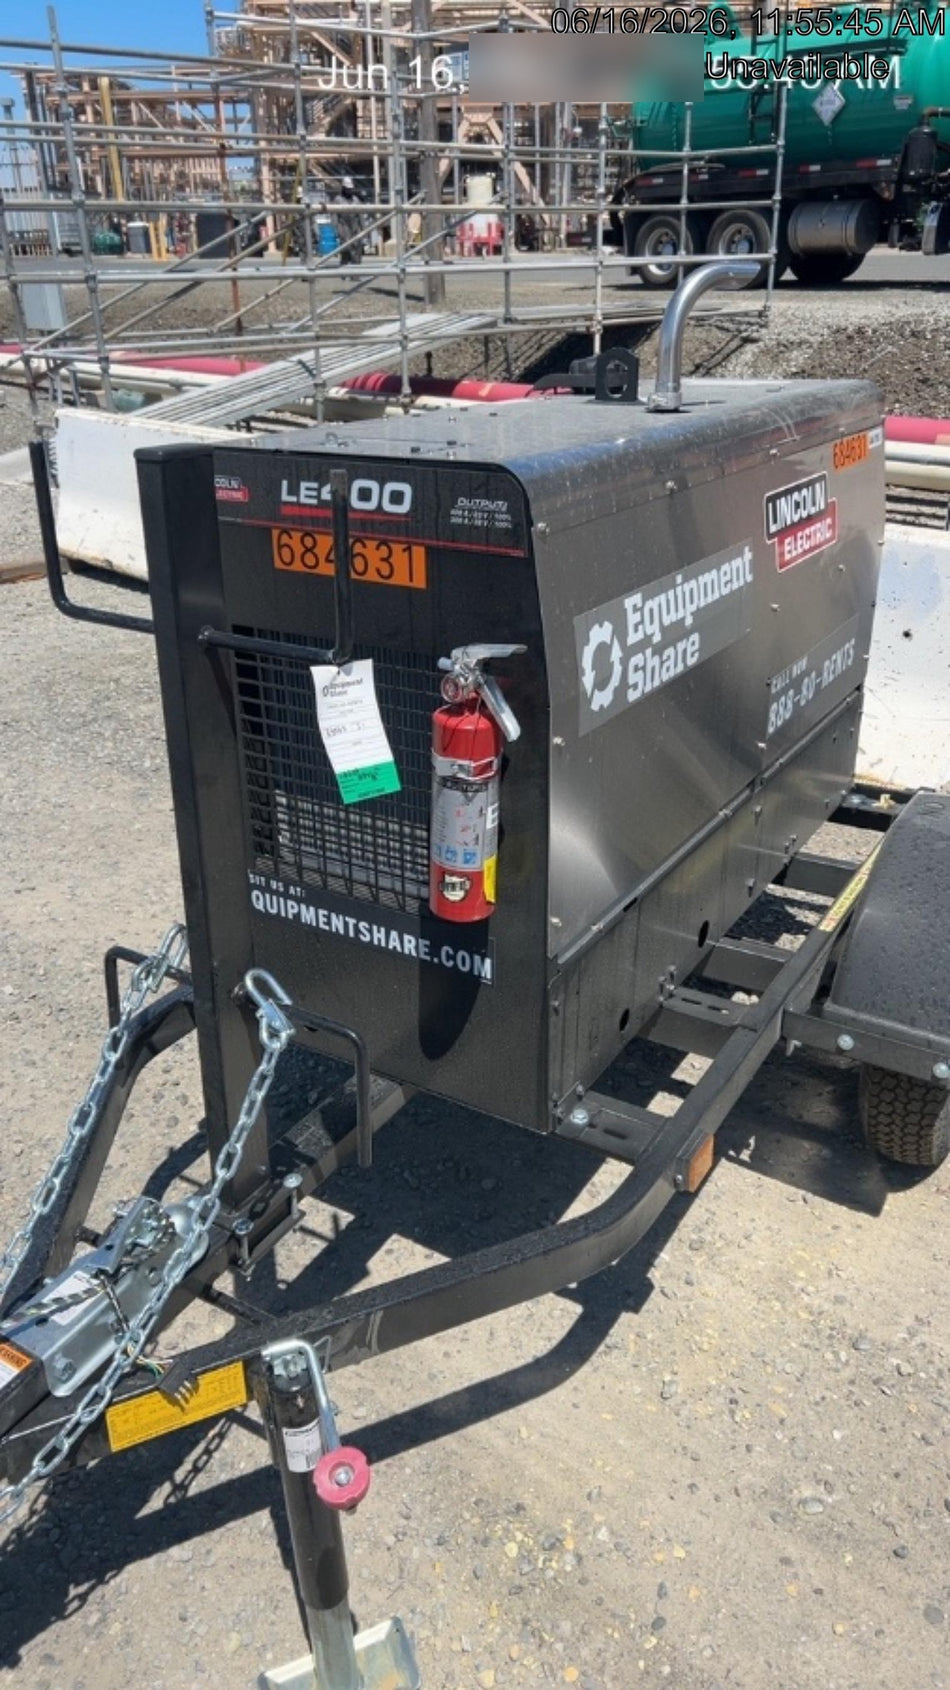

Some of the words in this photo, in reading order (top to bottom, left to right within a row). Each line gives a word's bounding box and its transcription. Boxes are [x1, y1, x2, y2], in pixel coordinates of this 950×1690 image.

[768, 480, 826, 534] LINCOLN
[784, 517, 833, 562] ELECTRIC
[624, 546, 753, 647] Equipment
[626, 632, 700, 704] Share
[270, 878, 285, 893] US
[250, 888, 493, 980] QUIPMENTSHARE.COM
